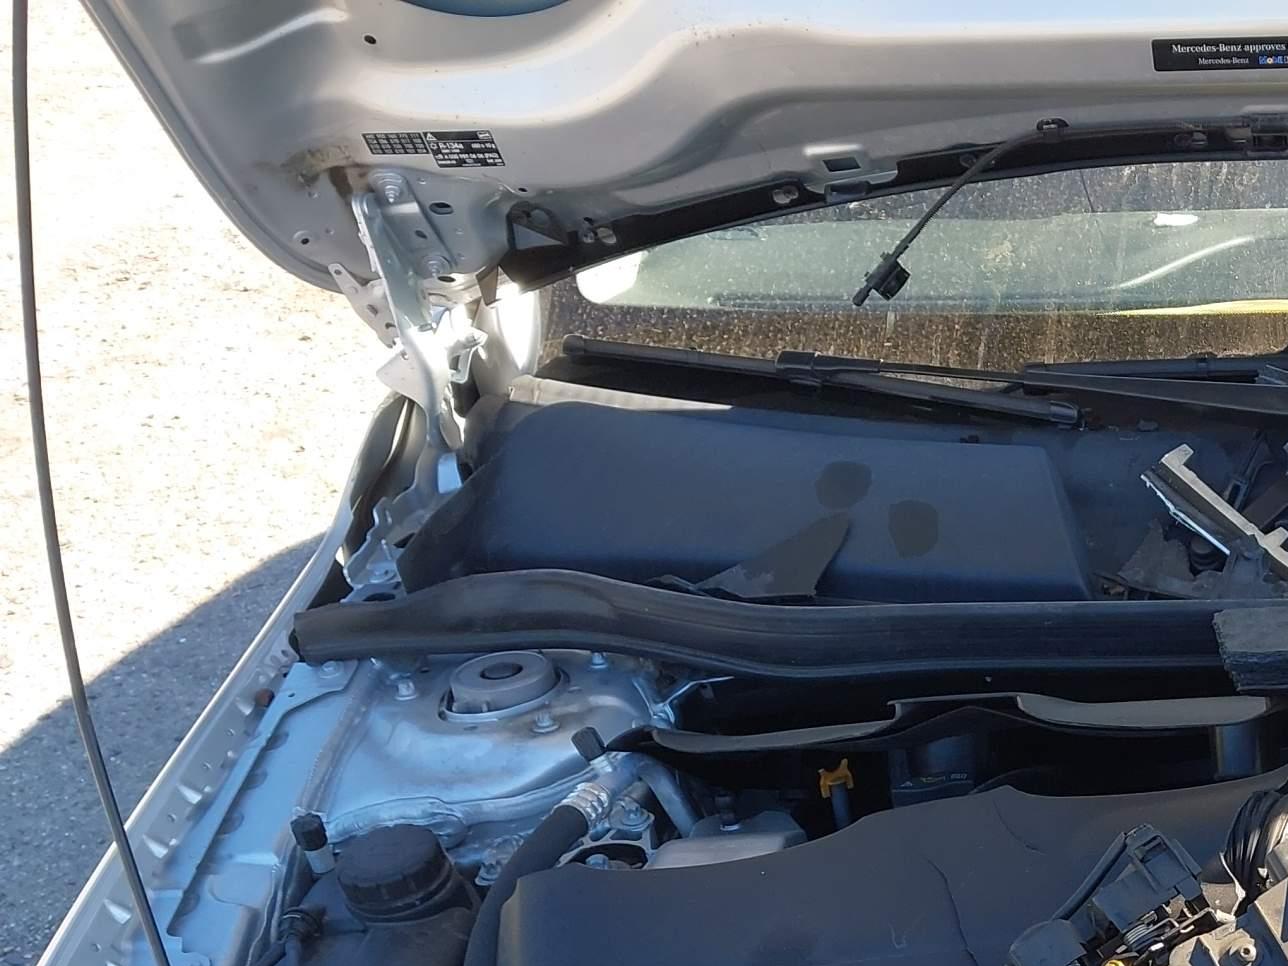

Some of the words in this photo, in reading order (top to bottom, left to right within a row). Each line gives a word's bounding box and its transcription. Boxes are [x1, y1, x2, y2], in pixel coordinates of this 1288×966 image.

[1171, 43, 1242, 53] Mercedes-Benz
[1243, 43, 1286, 53] approves
[1198, 56, 1249, 65] Mercedes-Benz
